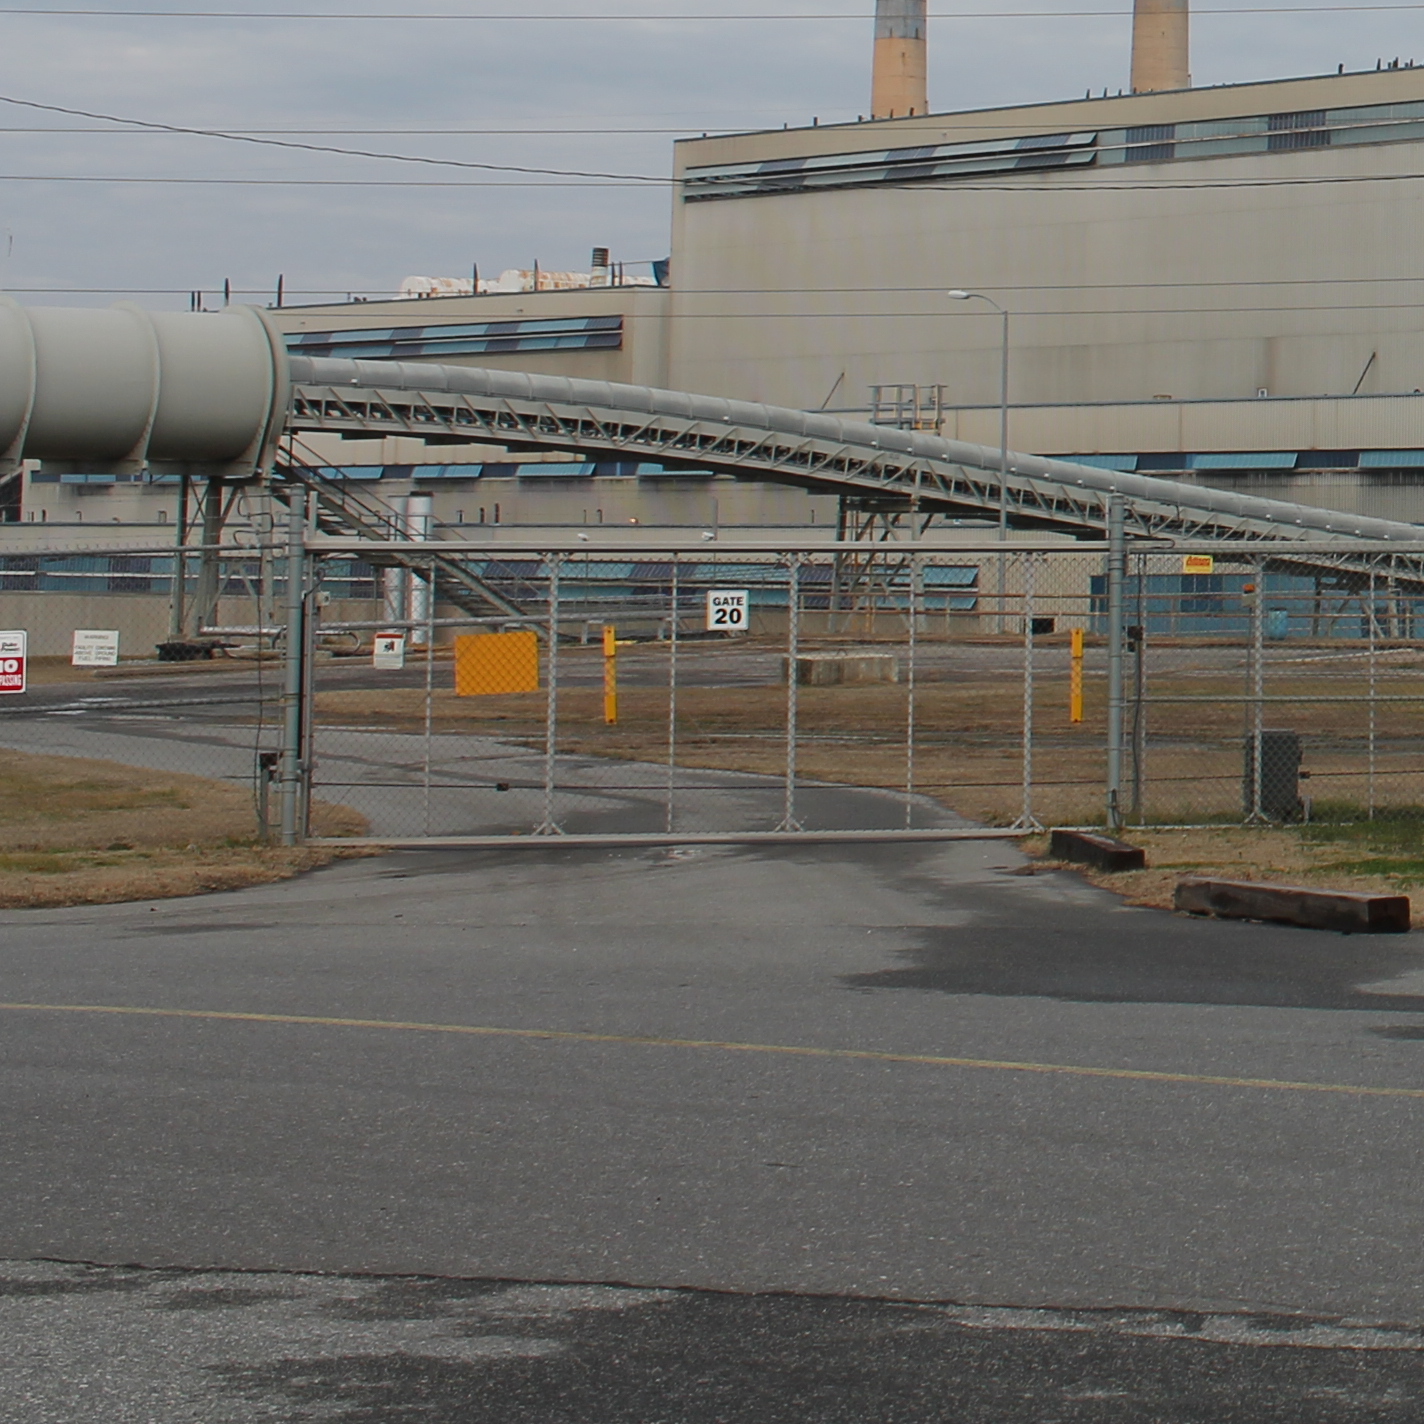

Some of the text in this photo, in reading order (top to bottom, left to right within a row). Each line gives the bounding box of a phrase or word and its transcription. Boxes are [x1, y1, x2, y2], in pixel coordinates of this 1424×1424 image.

[712, 596, 744, 606] GATE
[715, 608, 742, 624] 20
[0, 659, 19, 673] O
